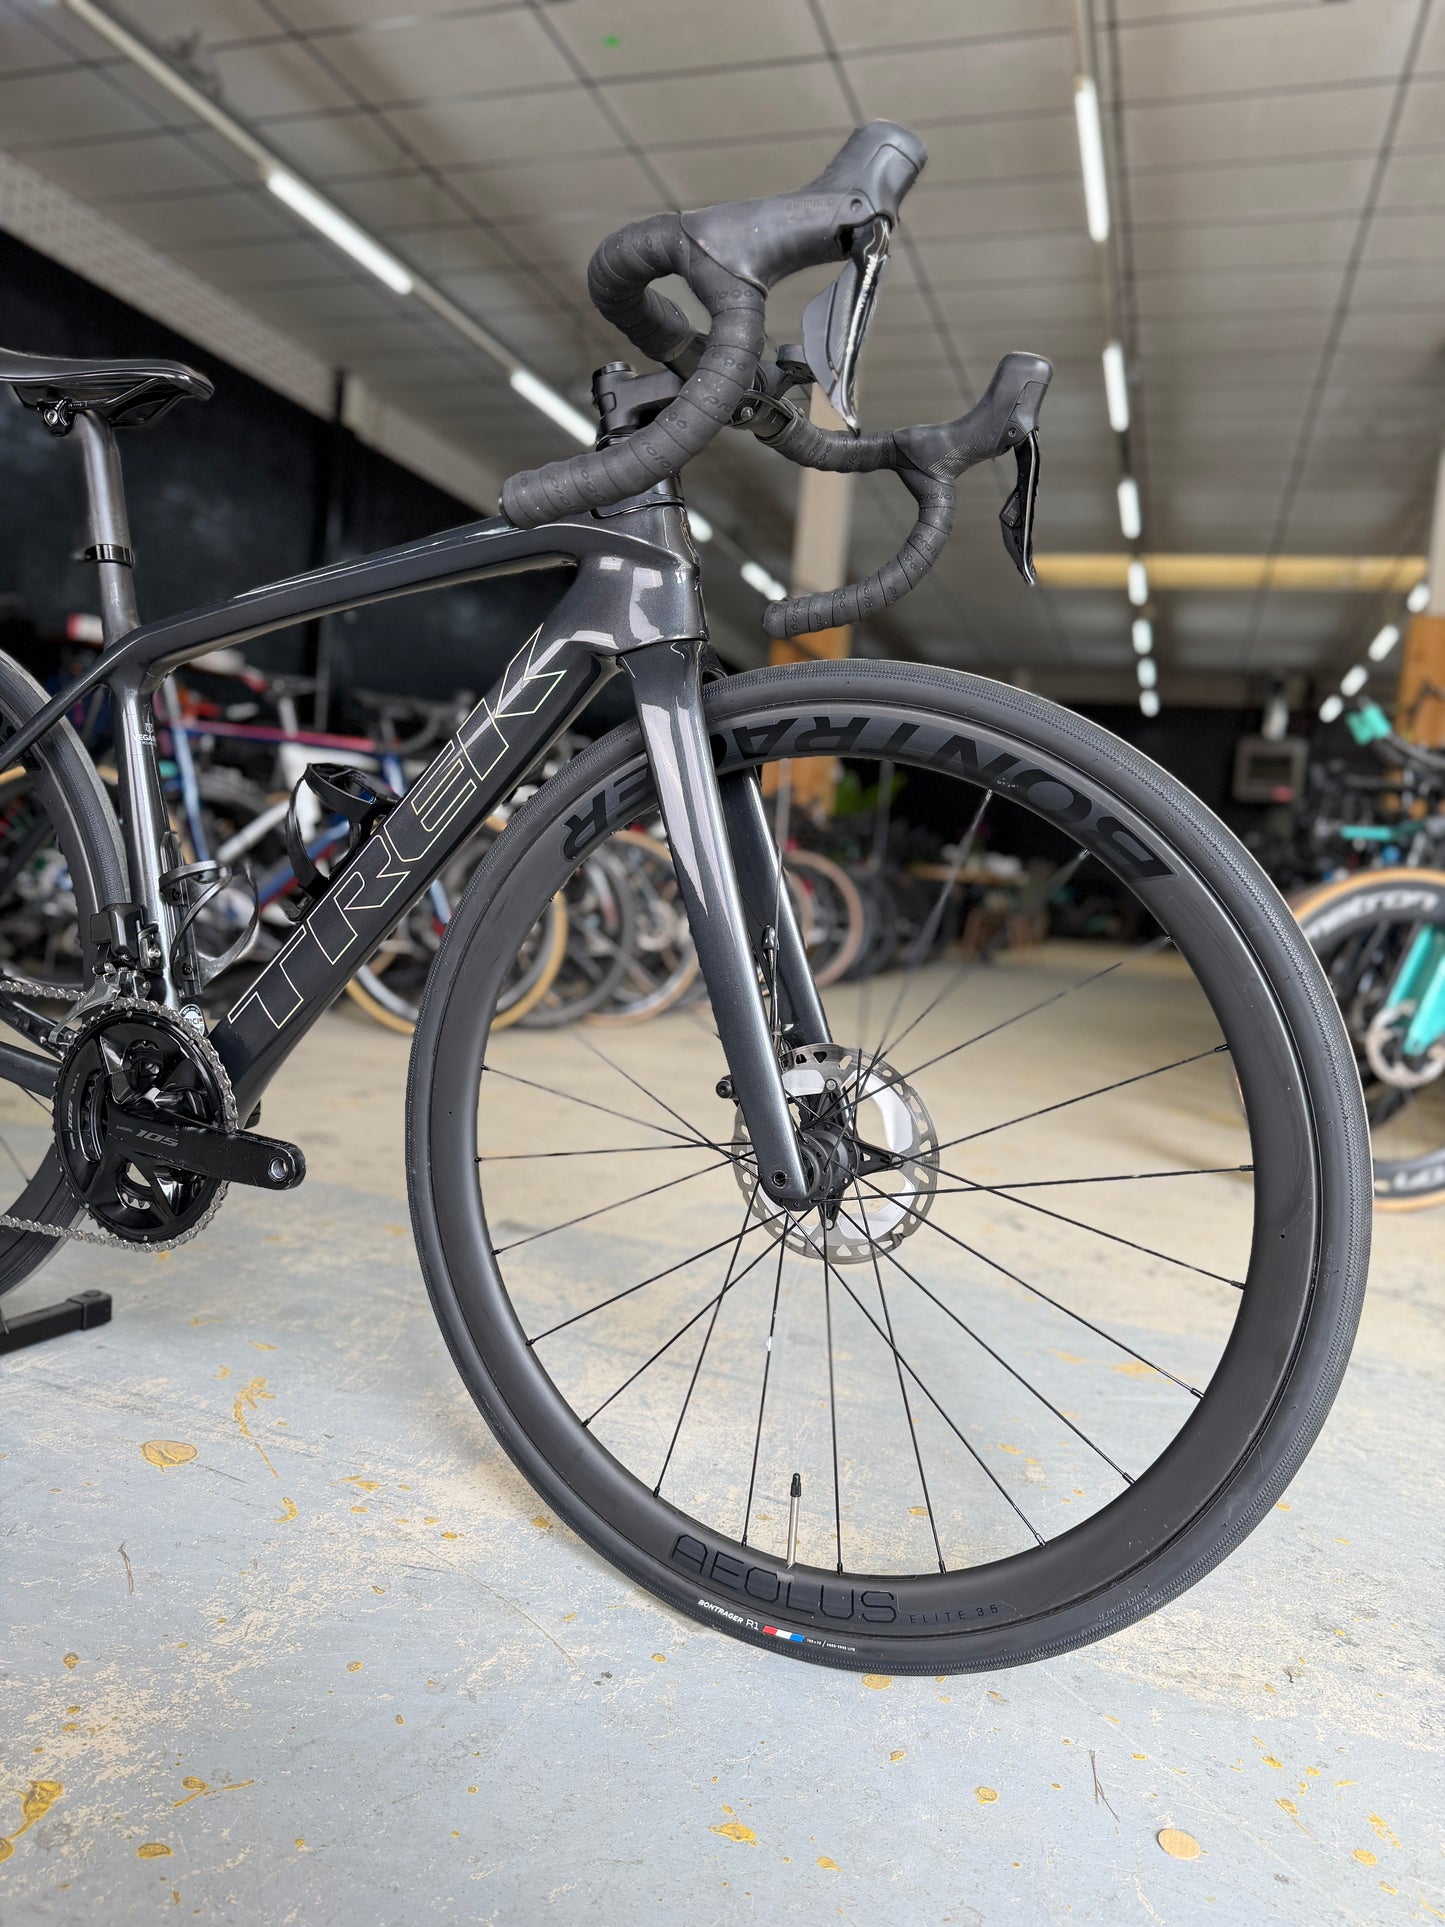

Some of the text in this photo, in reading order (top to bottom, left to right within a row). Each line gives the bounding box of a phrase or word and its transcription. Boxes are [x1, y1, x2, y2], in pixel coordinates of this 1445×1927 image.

[227, 623, 567, 1029] TREK
[136, 1129, 179, 1147] 105
[670, 1534, 897, 1623] AEOLUS
[698, 1599, 759, 1631] BONTRAGER R1
[909, 1603, 999, 1625] ELITE 35
